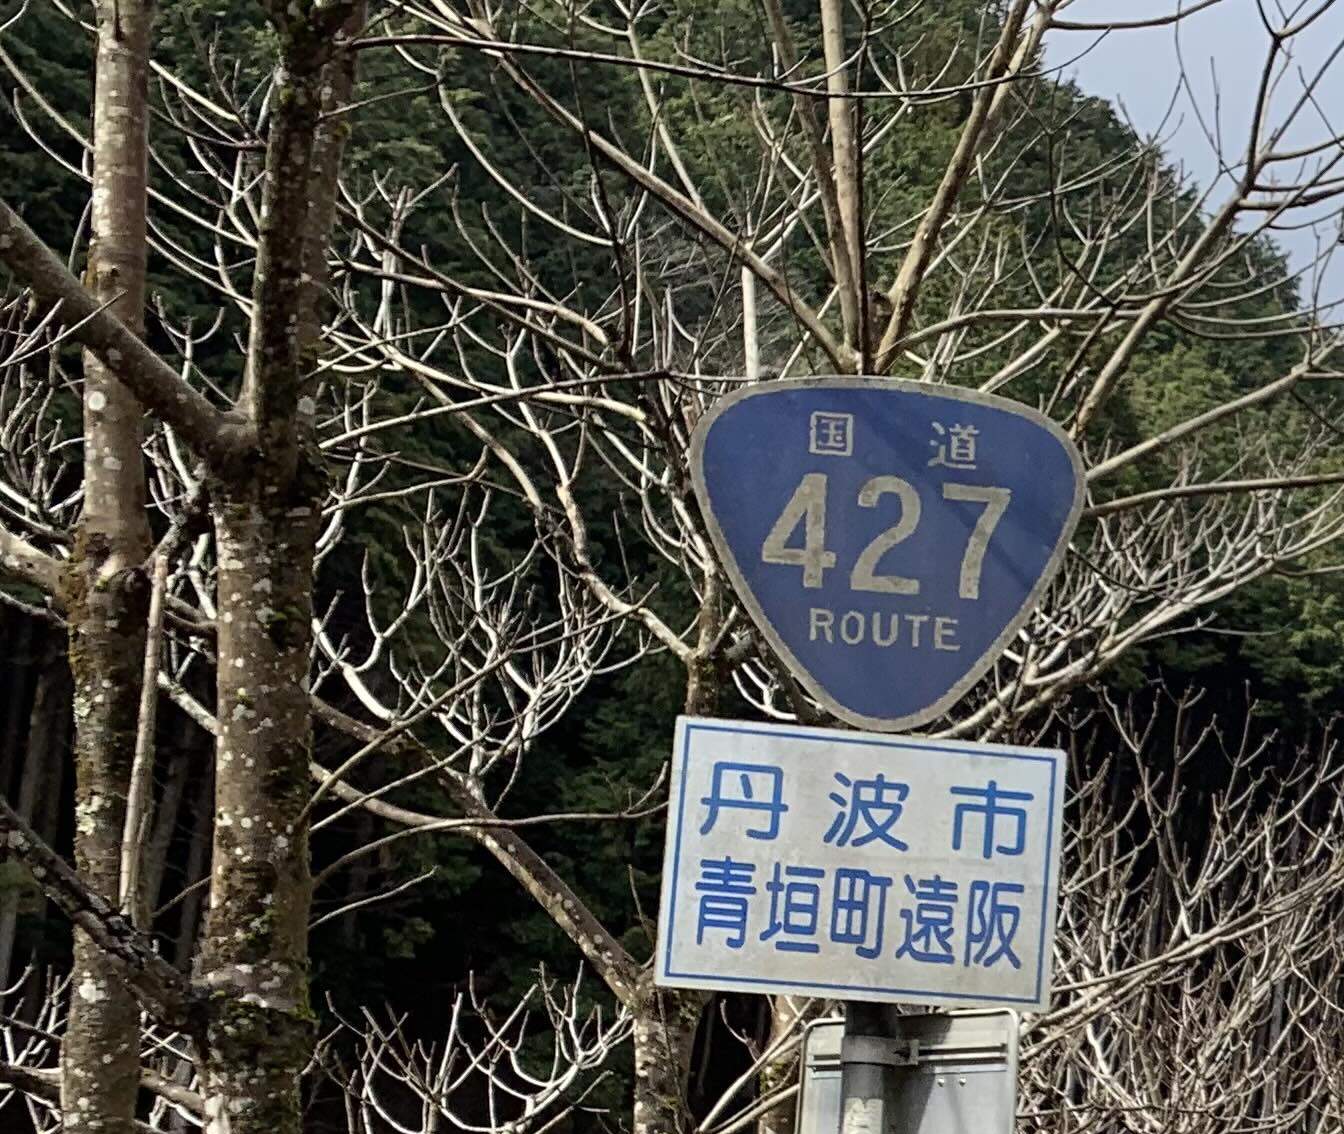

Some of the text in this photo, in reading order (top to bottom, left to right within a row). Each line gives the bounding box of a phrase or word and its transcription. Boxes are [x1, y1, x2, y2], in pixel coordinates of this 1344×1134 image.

[808, 410, 979, 471] 国道
[761, 472, 1012, 600] 427
[808, 607, 961, 652] ROUTE
[699, 760, 1035, 860] 丹波市
[694, 855, 1025, 970] 青垣町遠阪
